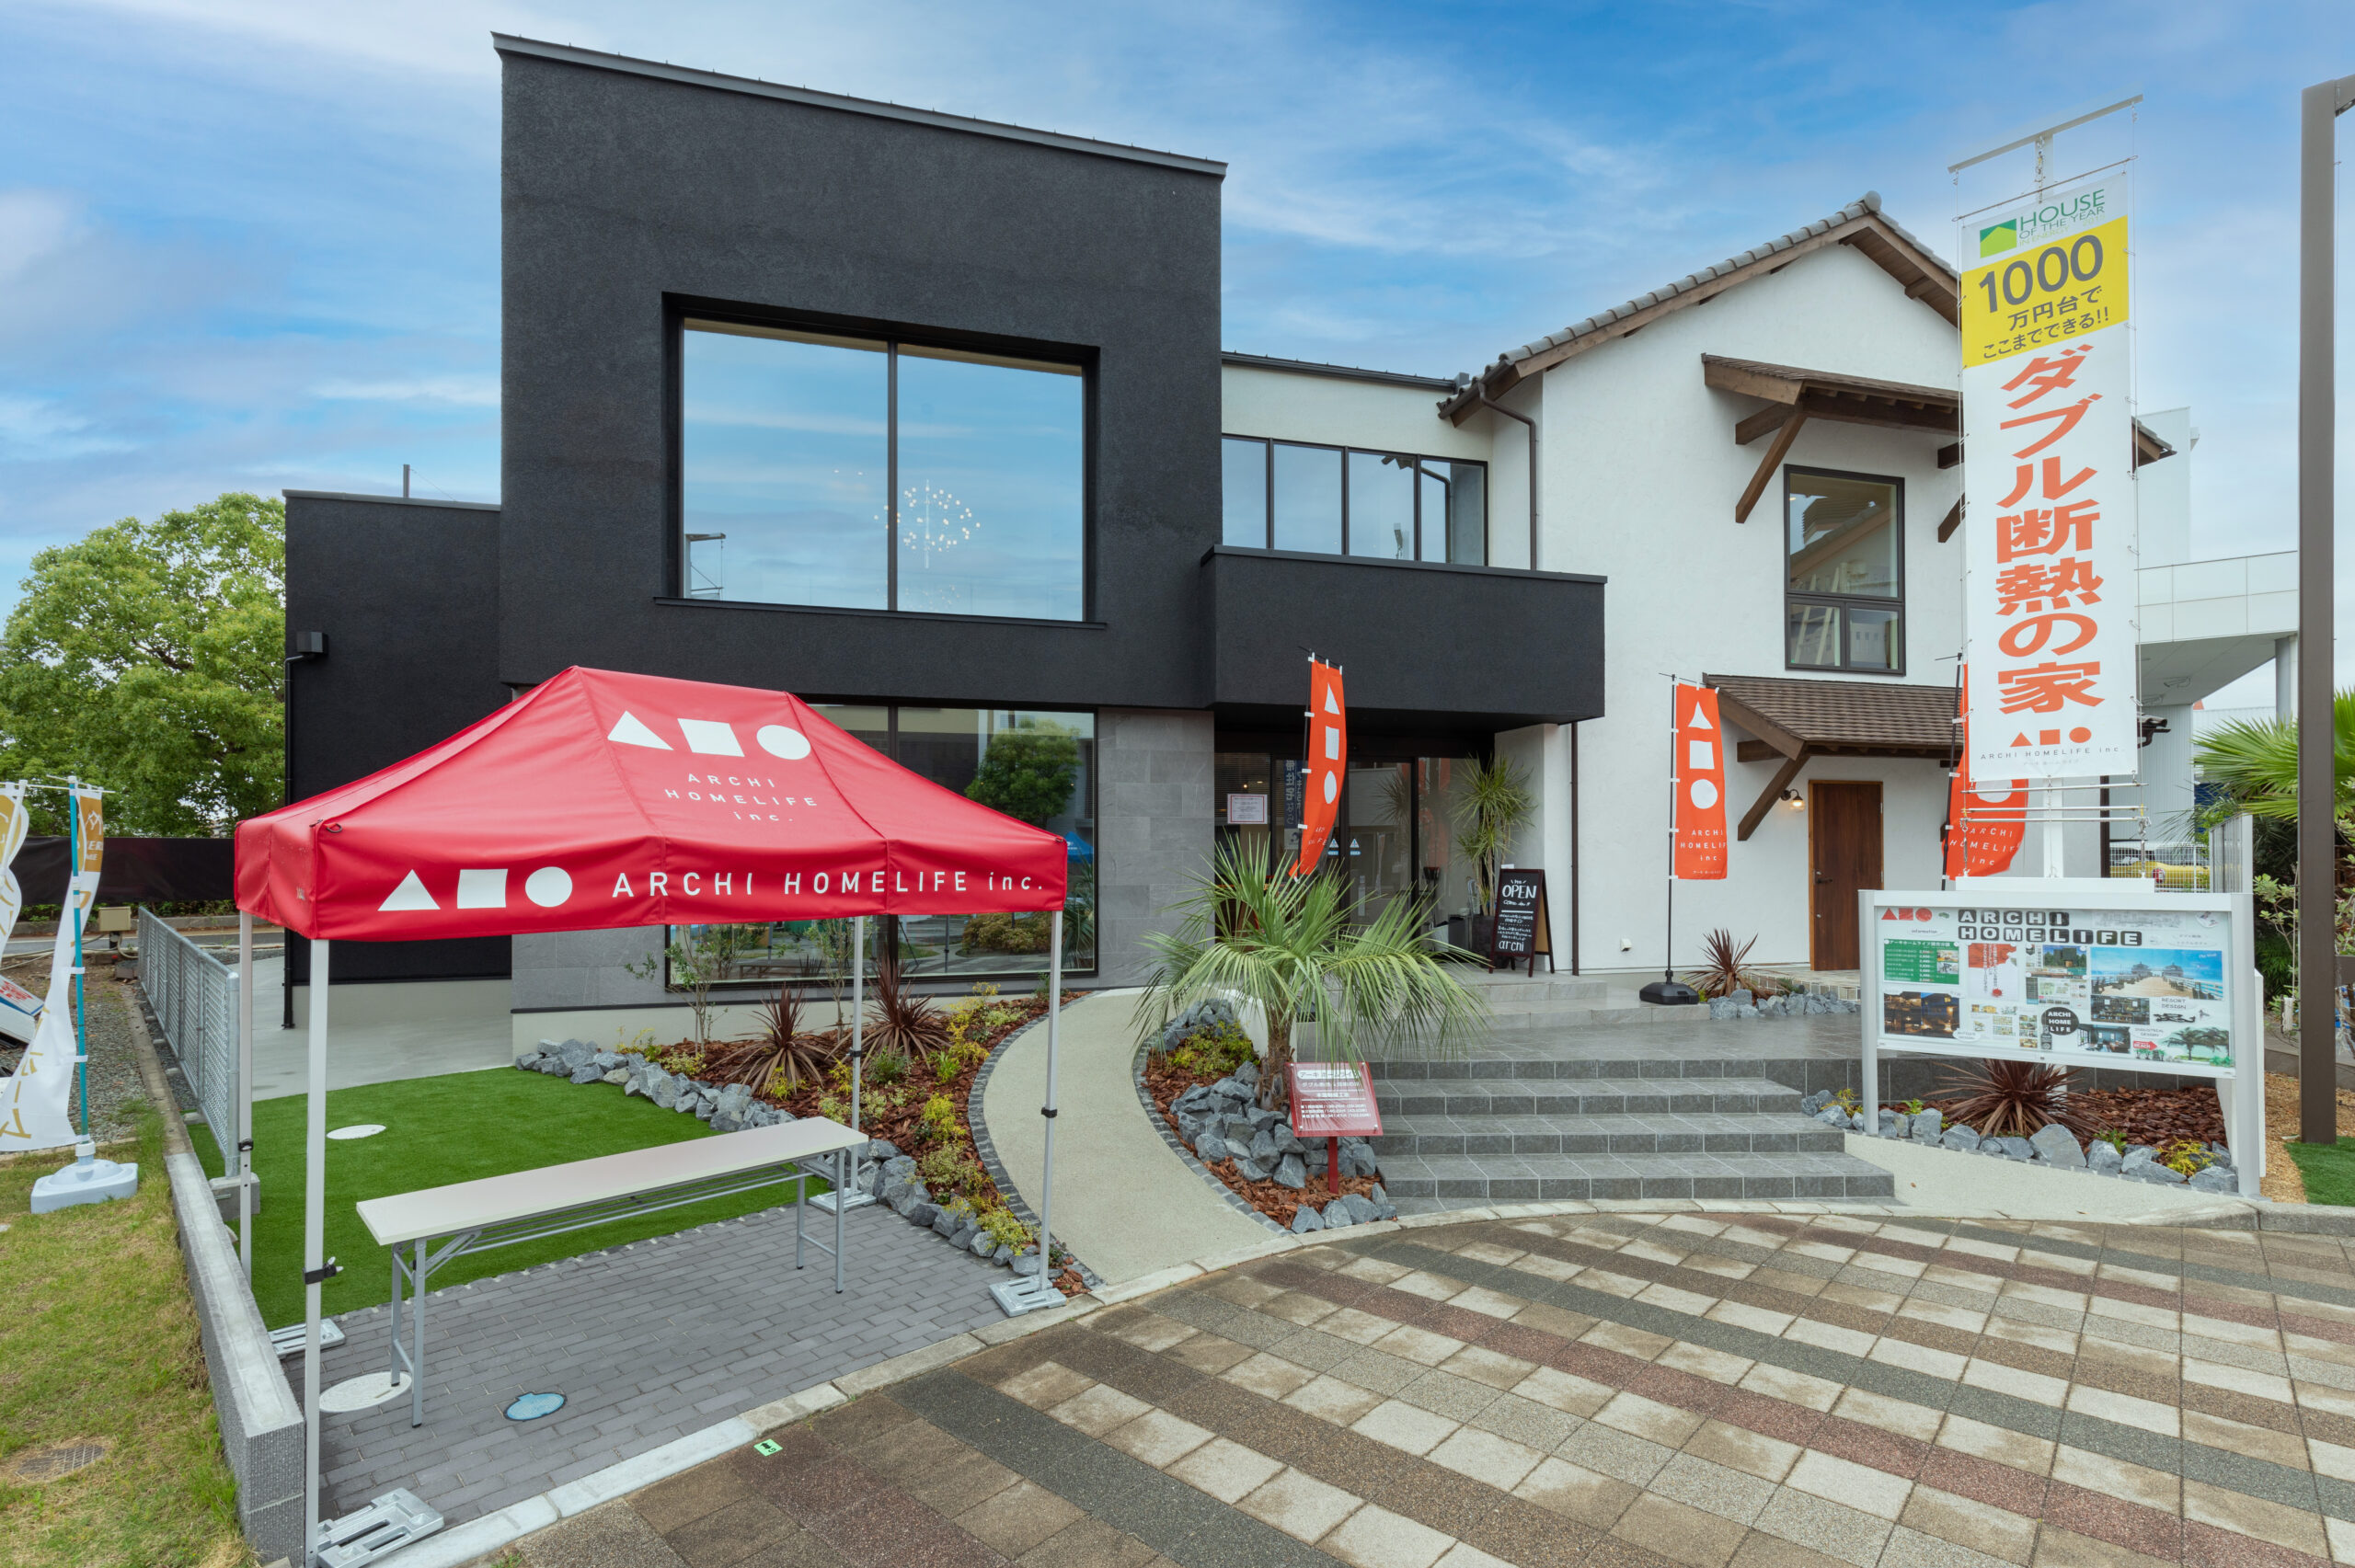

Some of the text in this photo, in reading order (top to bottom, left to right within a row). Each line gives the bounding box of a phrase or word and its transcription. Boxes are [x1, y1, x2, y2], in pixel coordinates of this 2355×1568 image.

[2019, 189, 2106, 228] HOUSE
[2019, 206, 2106, 239] OF THE YEAR
[1979, 235, 2104, 314] 1000
[2007, 285, 2103, 331] 万円台で
[1983, 306, 2109, 359] ここまでできる!!
[1994, 344, 2106, 715] ダブル断熱の家
[1981, 751, 2017, 760] ARCHI
[2026, 747, 2091, 758] HOMELIFE
[688, 773, 775, 788] ARCHI
[664, 788, 818, 807] HOMELIFE
[733, 811, 794, 822] inc.
[1970, 828, 2013, 838] ARCHI
[612, 870, 1043, 898] ARCHI HOMELIFE inc.
[1502, 885, 1537, 898] OPEN
[1959, 910, 2067, 926] ARCHI
[1959, 927, 2141, 945] HOMELIFE
